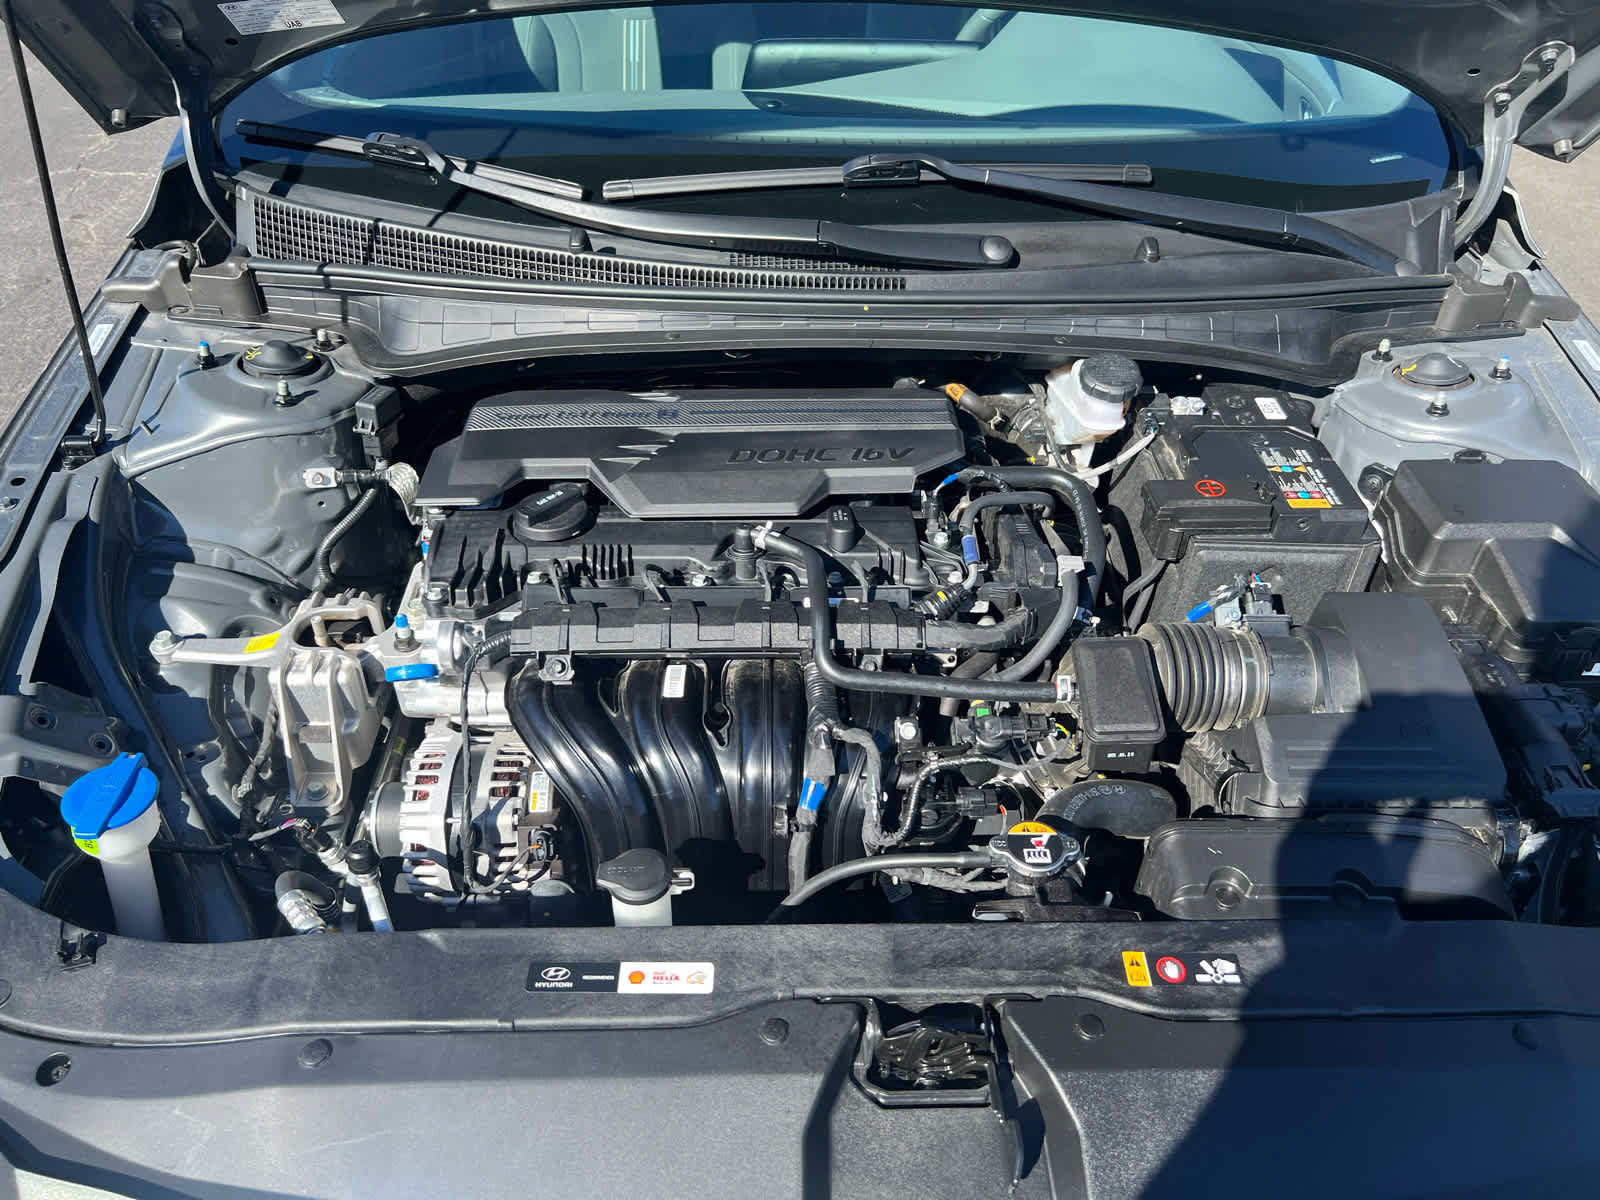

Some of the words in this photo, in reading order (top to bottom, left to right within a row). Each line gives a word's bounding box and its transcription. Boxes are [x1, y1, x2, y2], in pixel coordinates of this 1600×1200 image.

[727, 447, 842, 464] DOHC
[850, 447, 915, 461] 16V
[652, 974, 681, 982] HELIX
[534, 981, 573, 989] HYUNDAI
